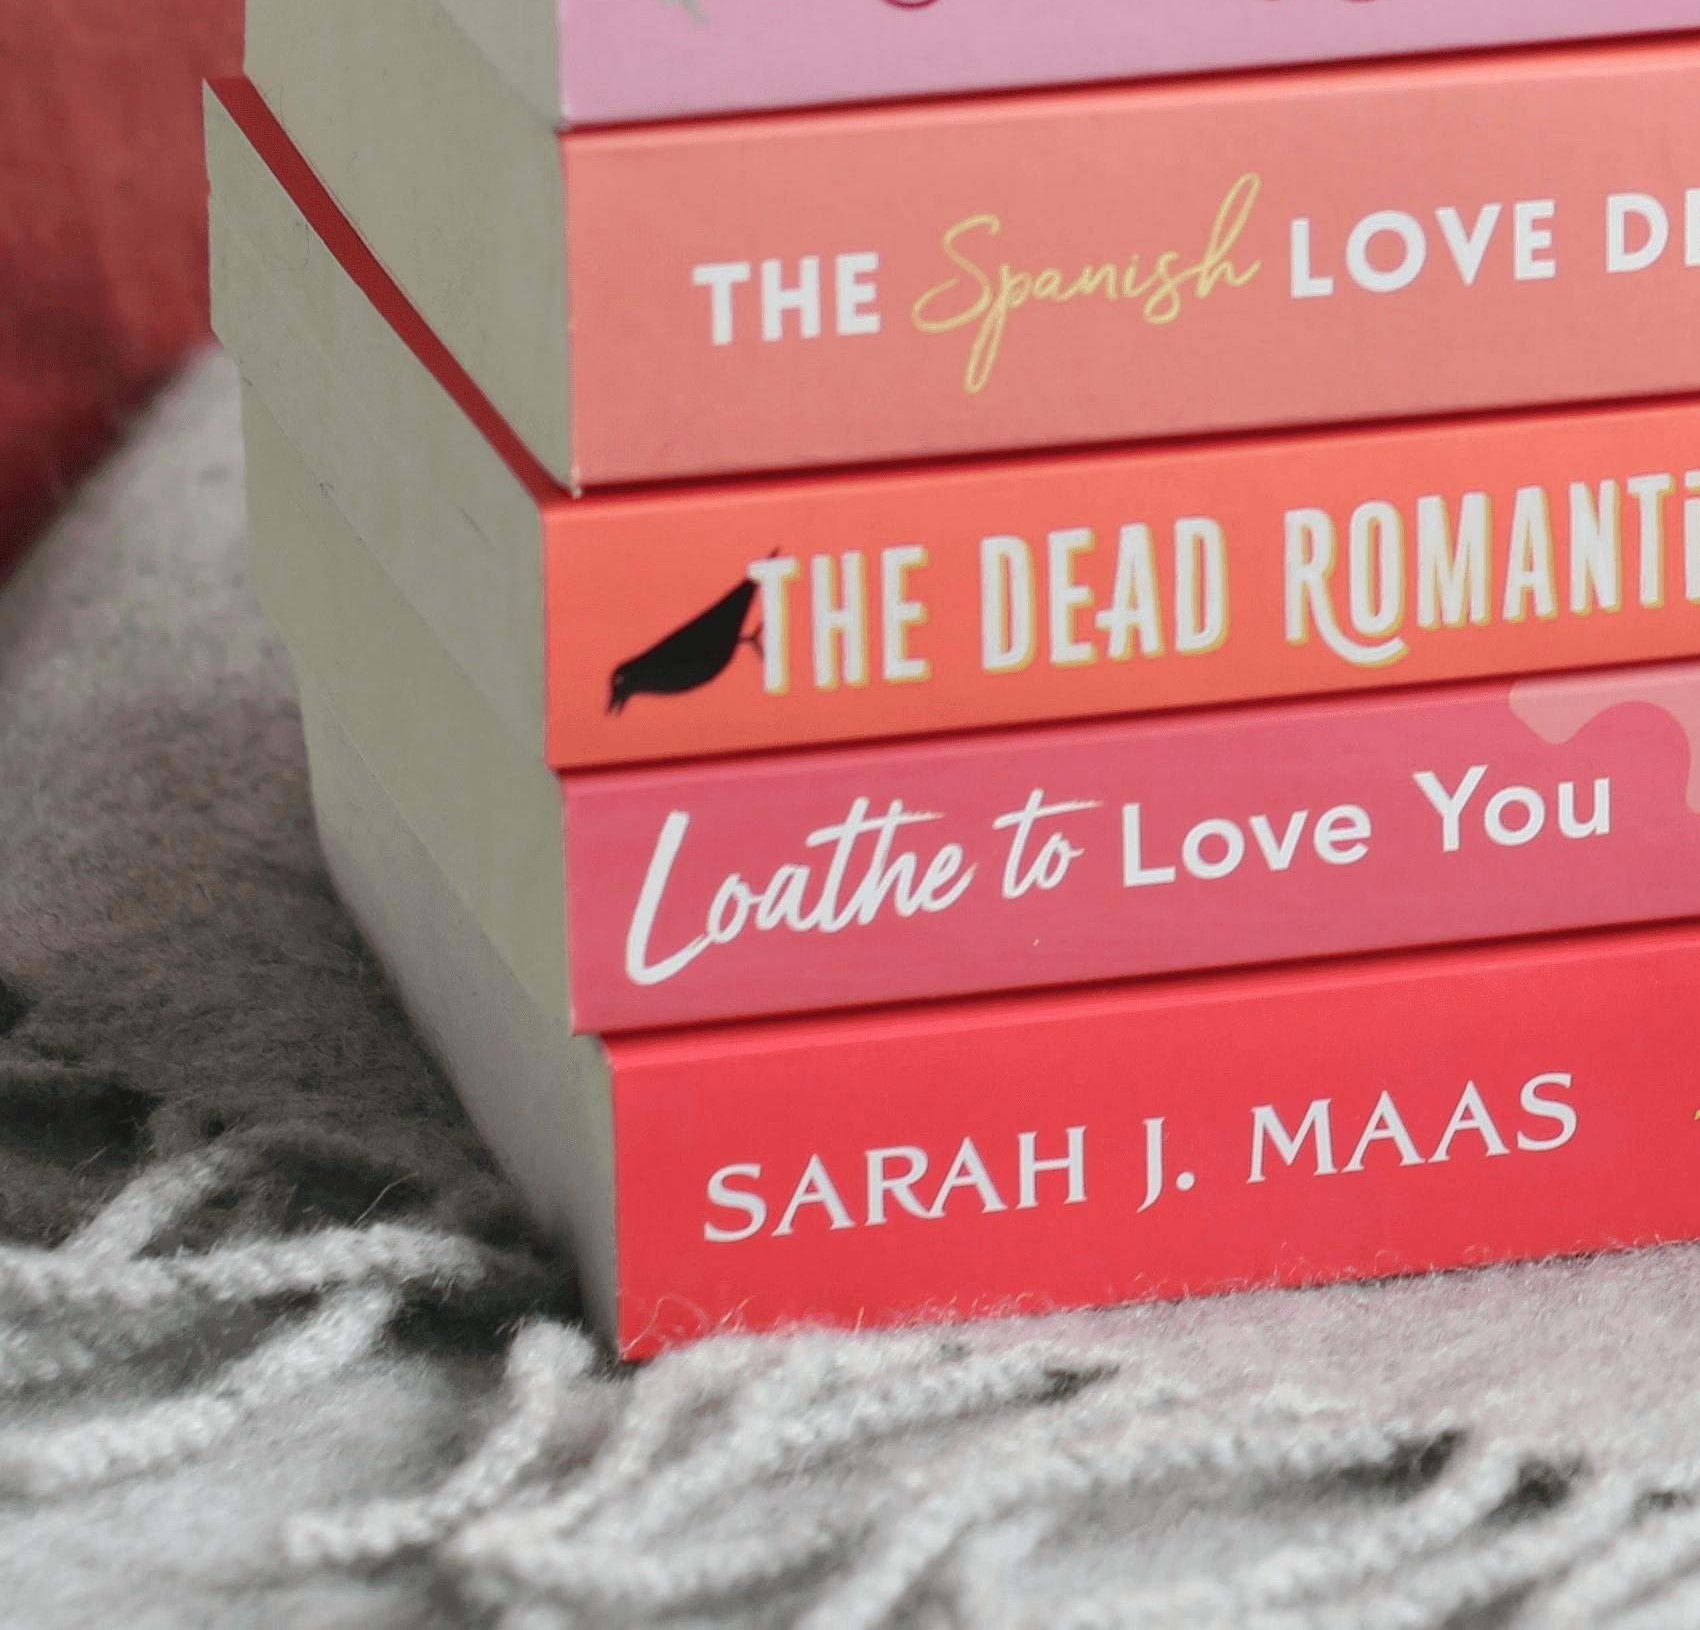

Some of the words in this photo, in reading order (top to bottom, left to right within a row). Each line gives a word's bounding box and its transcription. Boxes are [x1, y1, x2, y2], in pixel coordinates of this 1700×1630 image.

[691, 251, 882, 346] THE
[910, 172, 1264, 394] Spanish
[1289, 198, 1558, 299] LOVE
[748, 544, 931, 694] THE
[980, 516, 1228, 674] DEAD
[624, 796, 980, 987] Loathe
[993, 788, 1103, 900] to
[1120, 801, 1373, 889] Love
[1413, 764, 1613, 853] You
[702, 1123, 1089, 1243] SARAH
[1136, 1115, 1198, 1213] J.
[1246, 1071, 1579, 1184] MAAS
